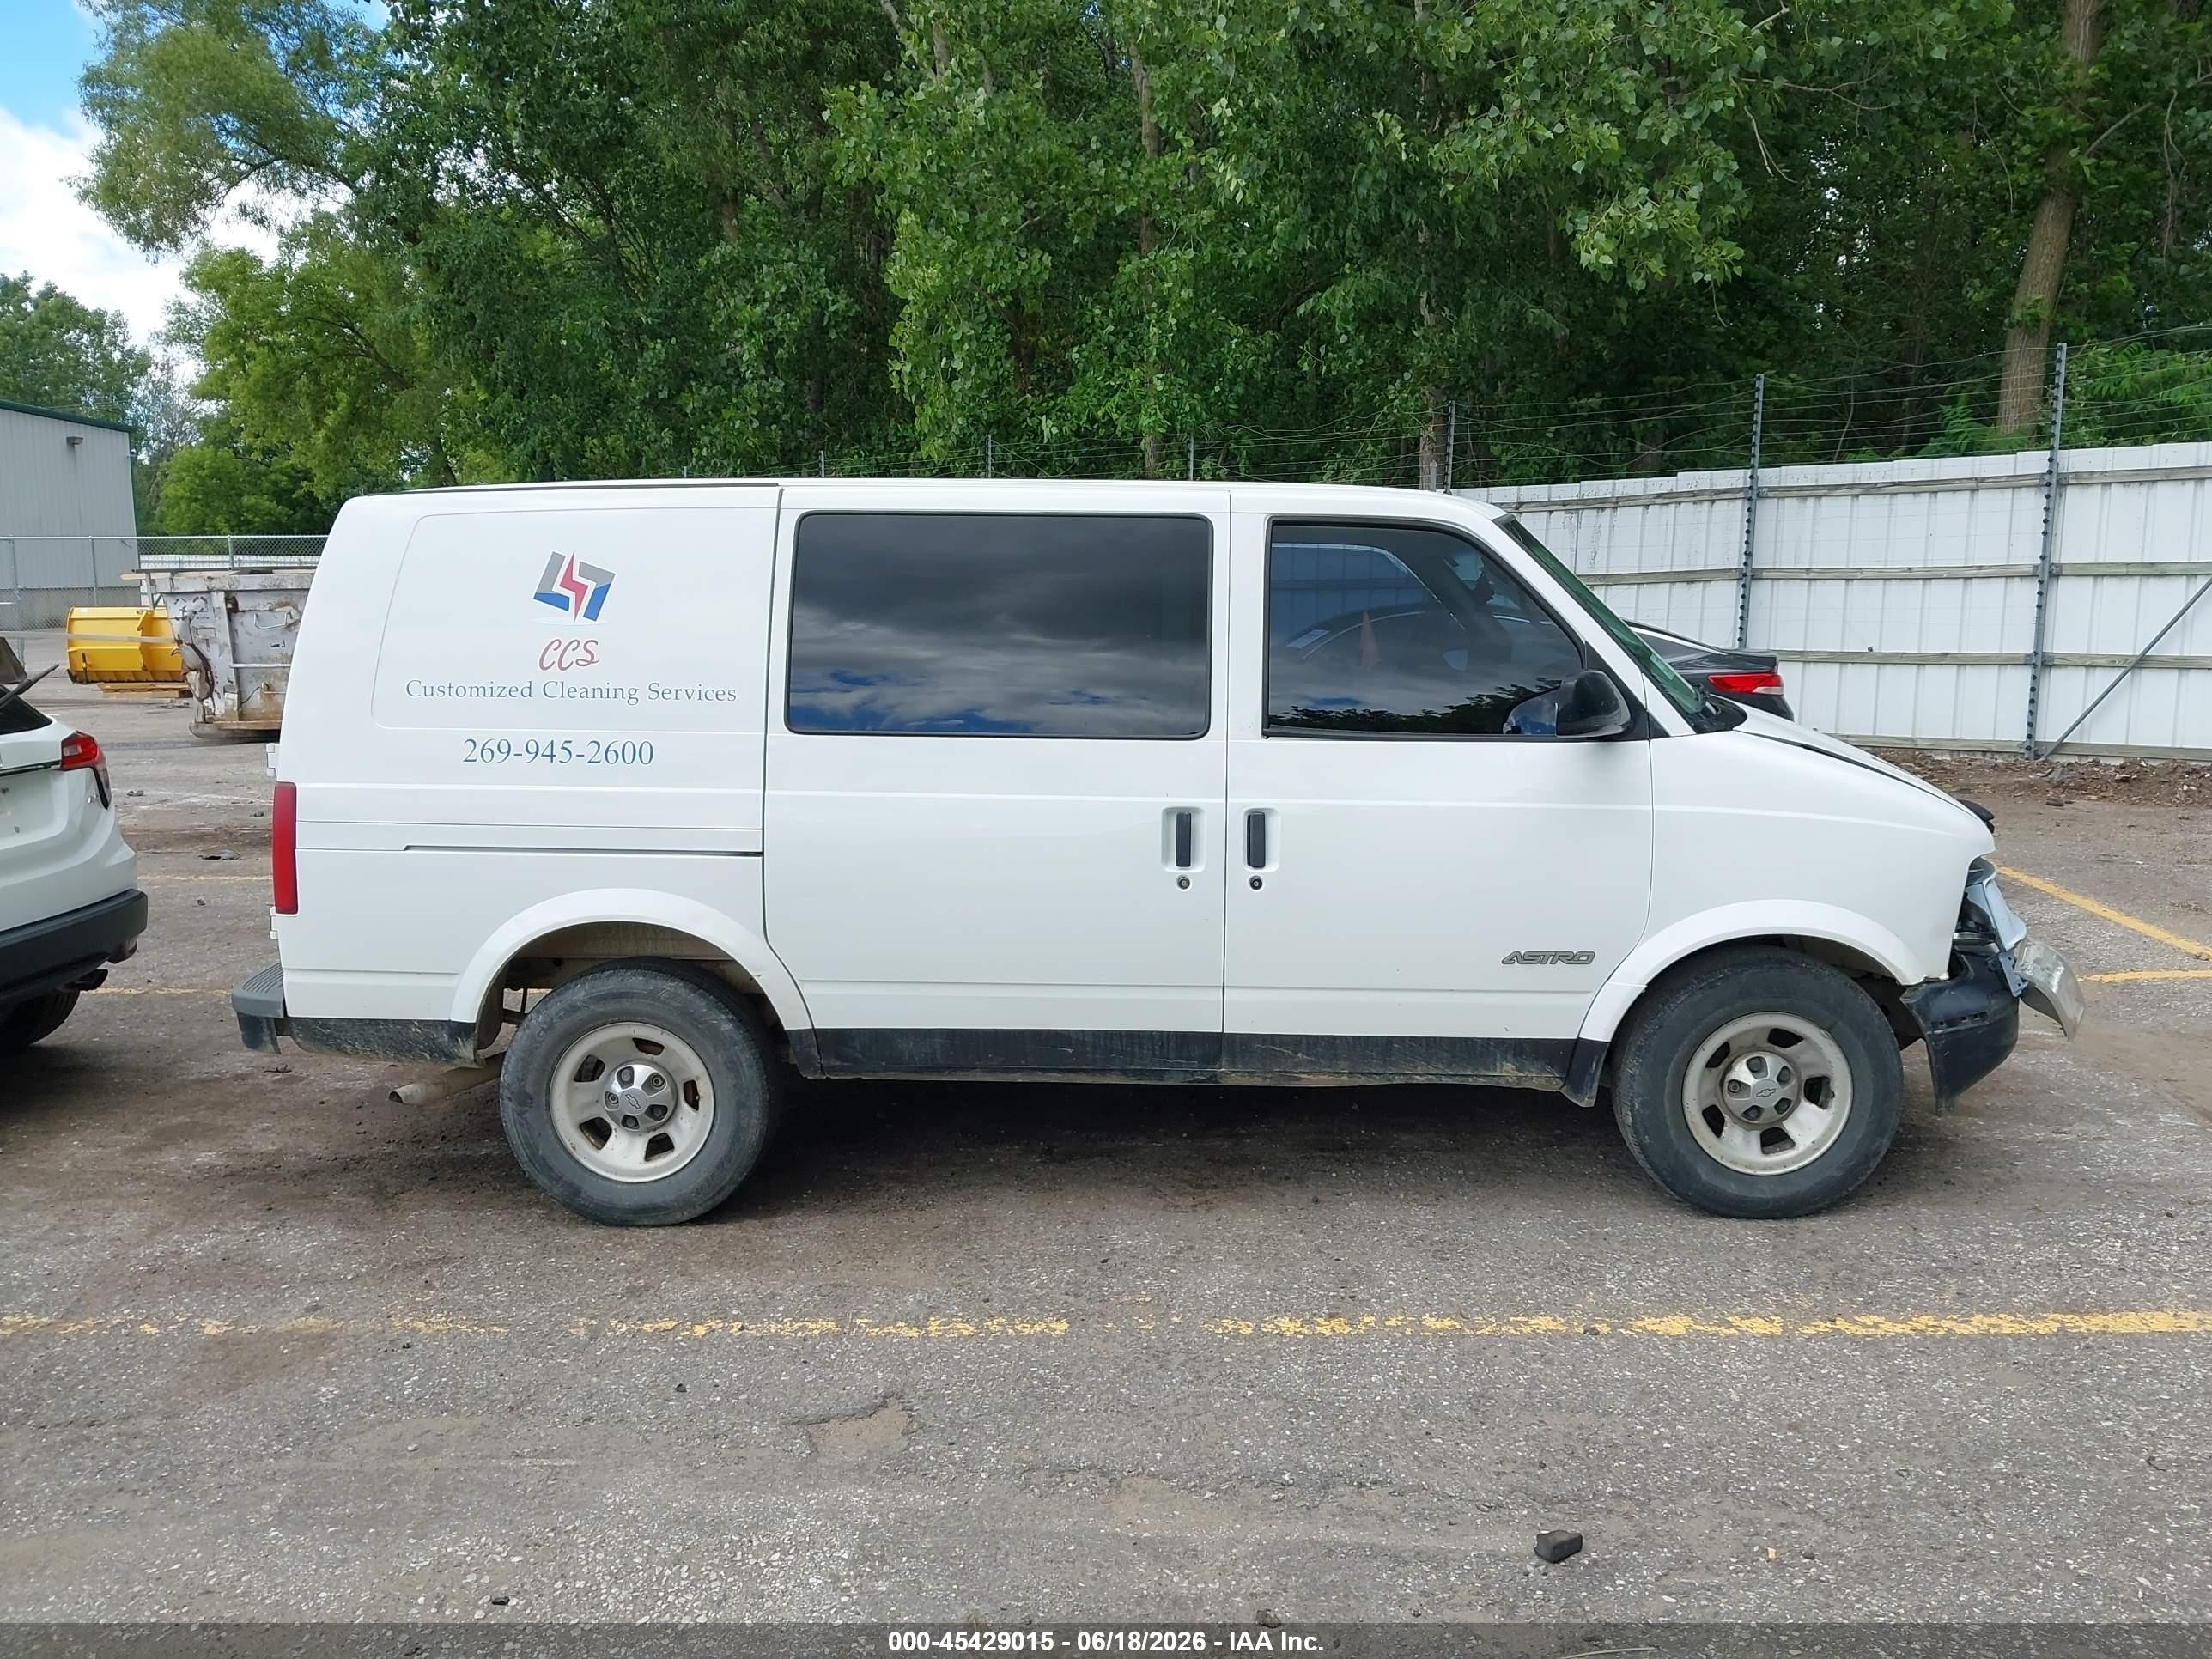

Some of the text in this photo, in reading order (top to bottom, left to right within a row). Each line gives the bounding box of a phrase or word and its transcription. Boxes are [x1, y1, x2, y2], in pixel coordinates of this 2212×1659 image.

[538, 638, 600, 672] CCS
[405, 679, 737, 706] Customized Cleaning Services
[462, 738, 654, 766] 269-945-2600
[1501, 951, 1596, 965] ASTRO
